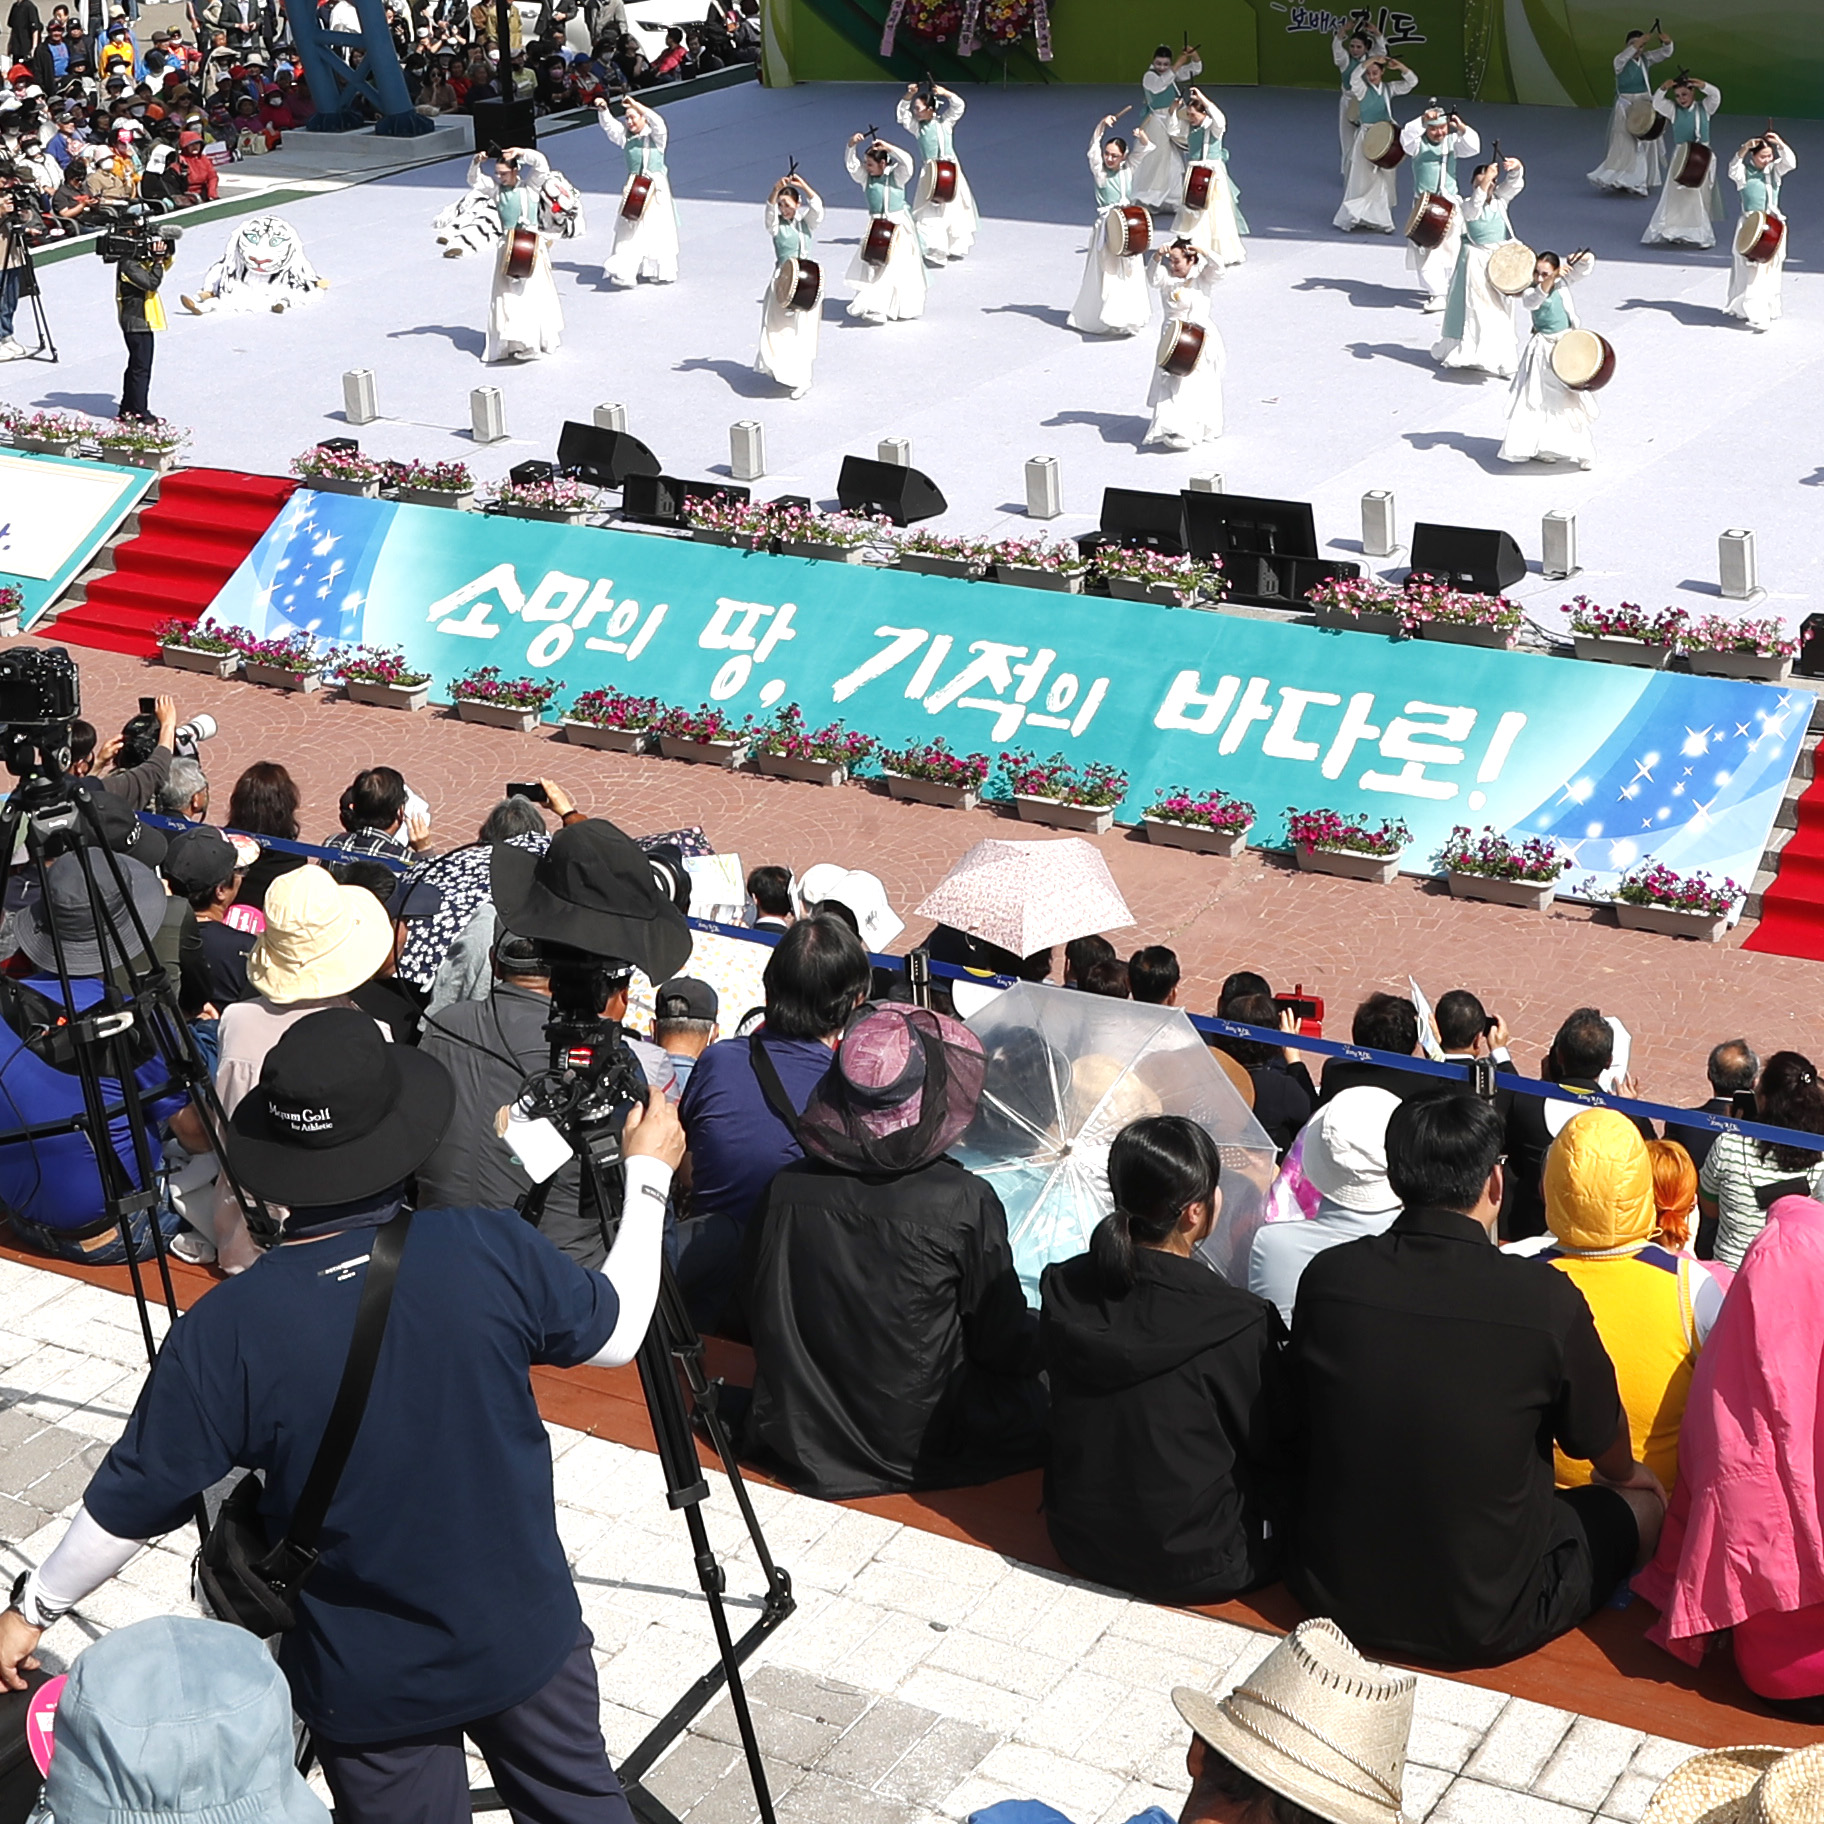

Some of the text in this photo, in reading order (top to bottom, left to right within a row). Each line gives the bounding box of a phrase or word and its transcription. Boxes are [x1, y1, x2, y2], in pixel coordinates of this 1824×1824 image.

[427, 562, 667, 668] 소망의
[834, 625, 1108, 743] 기적의
[1154, 669, 1527, 809] 바다로!
[302, 1108, 330, 1122] Golf
